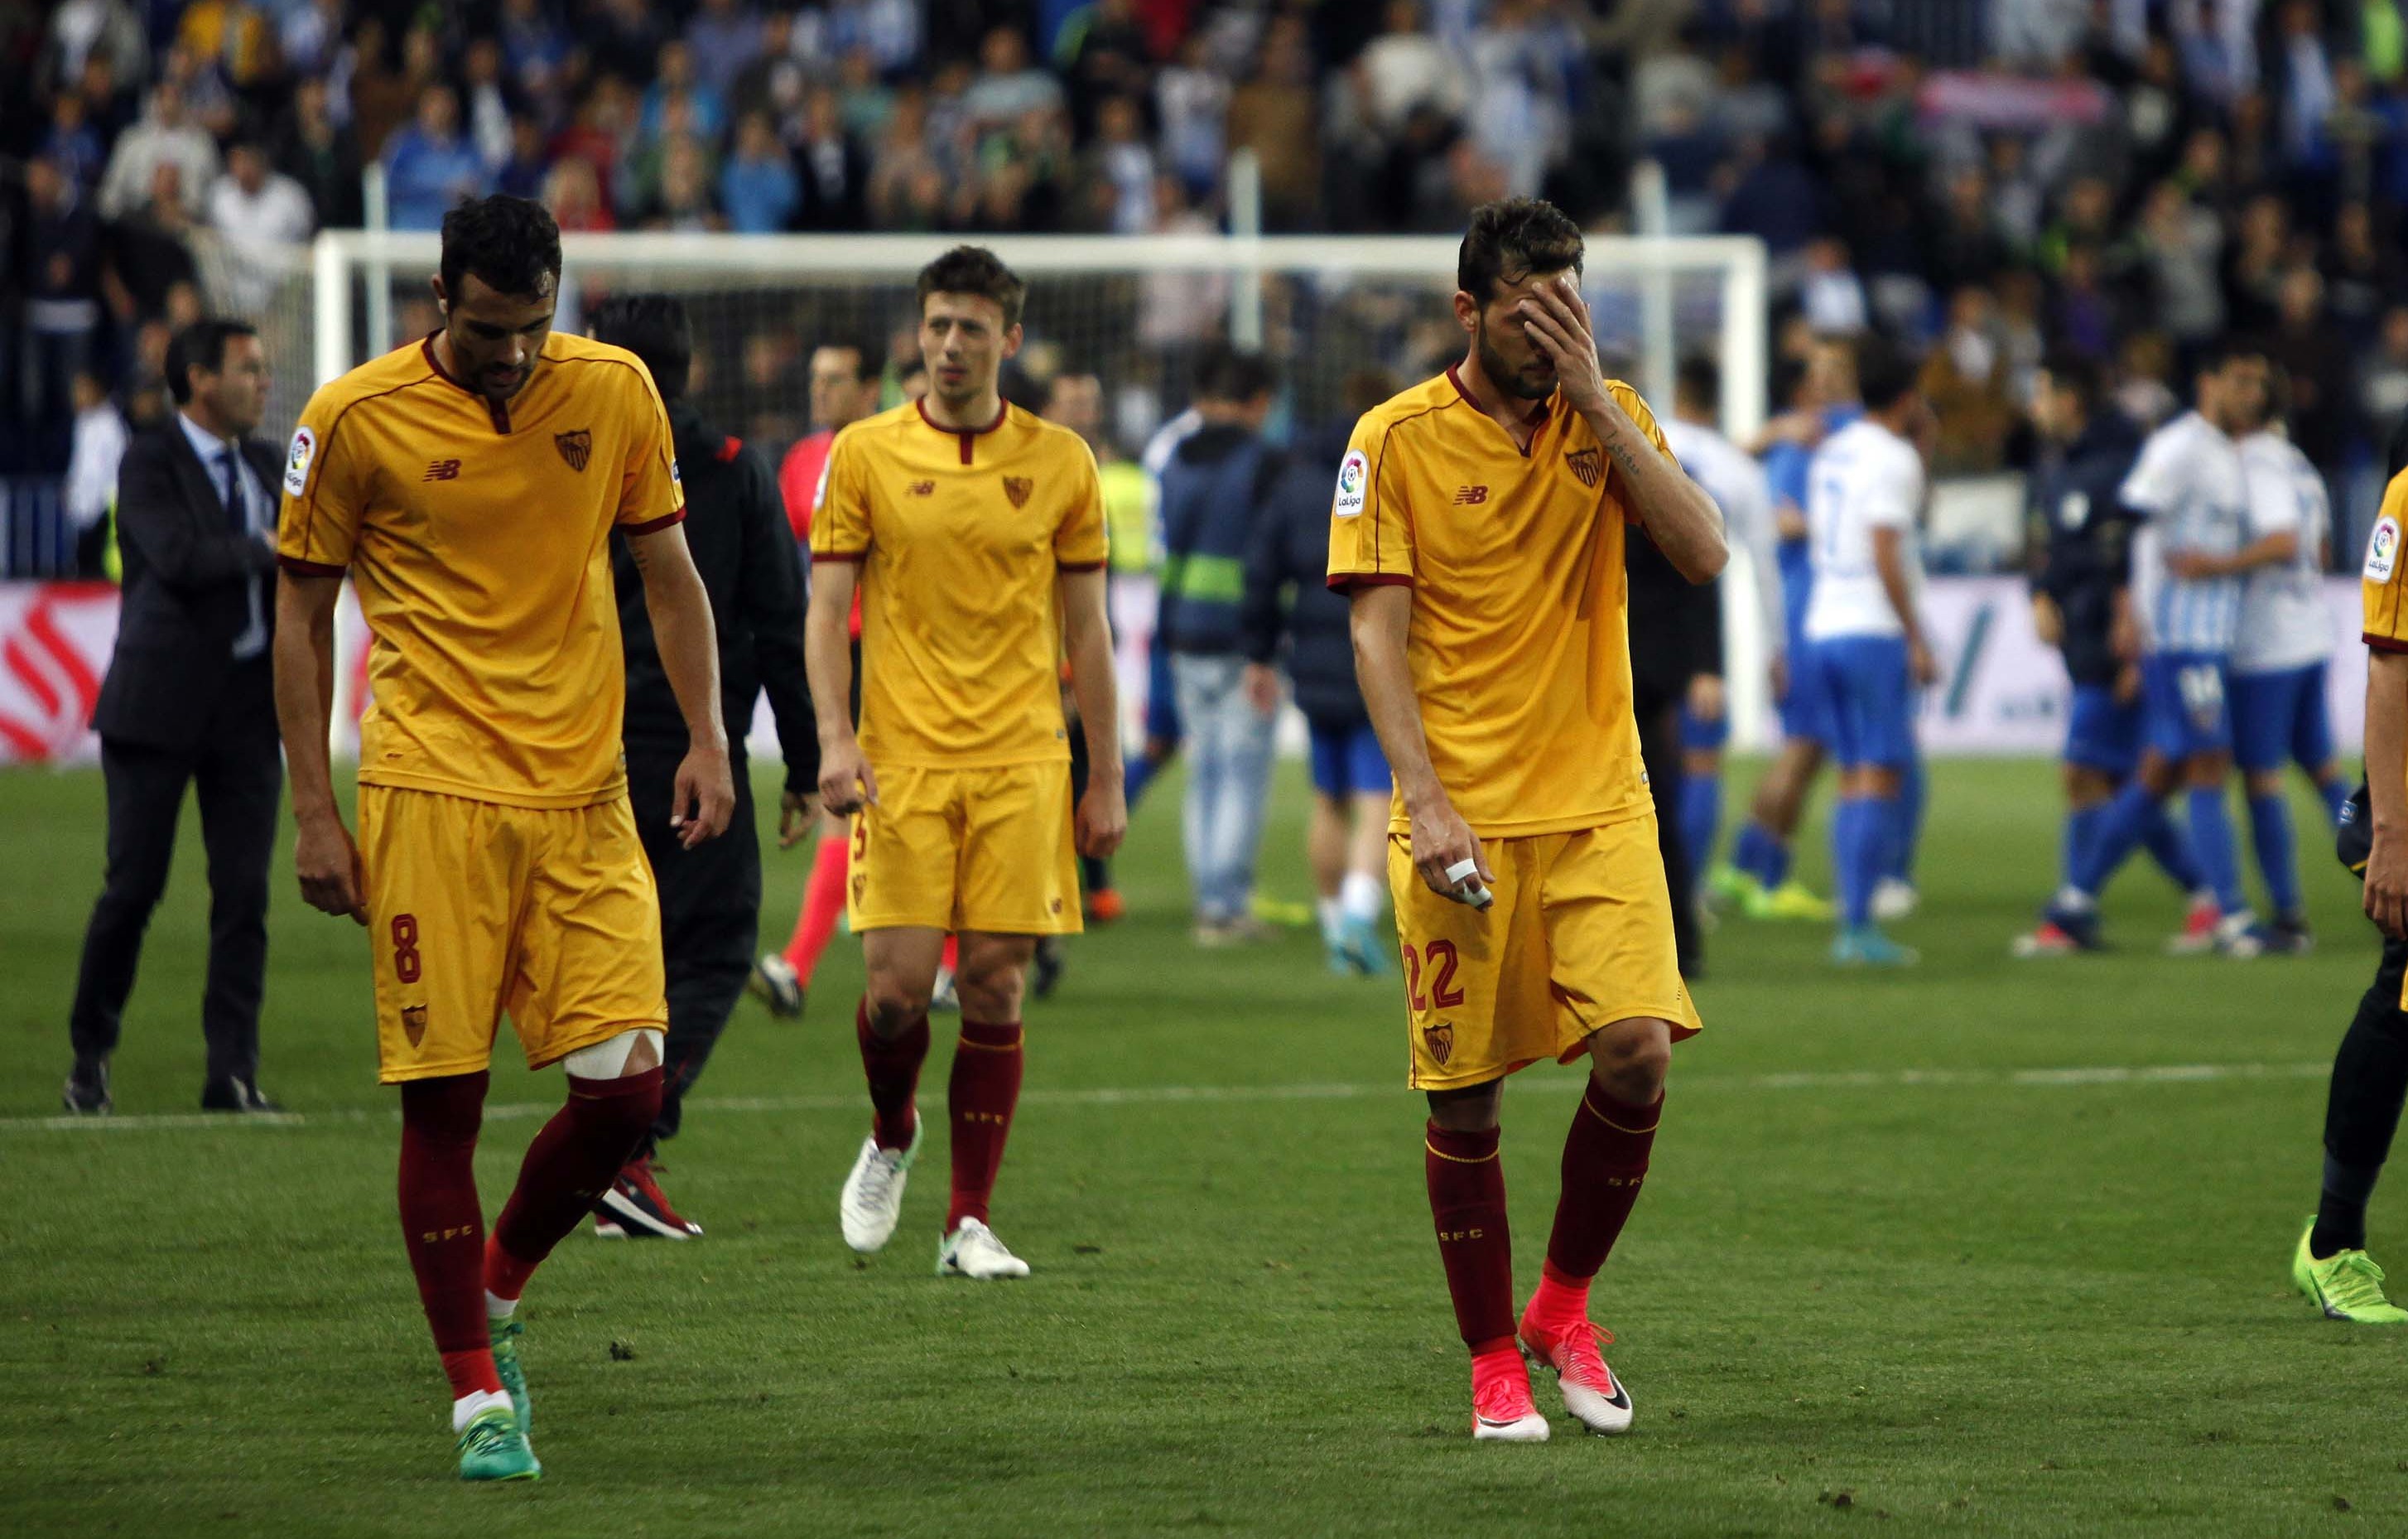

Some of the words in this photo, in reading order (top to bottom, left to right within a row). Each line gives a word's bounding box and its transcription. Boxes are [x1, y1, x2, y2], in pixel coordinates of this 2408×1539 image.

[422, 458, 462, 482] NB
[1338, 495, 1361, 507] LaLiga
[1452, 485, 1488, 505] NB
[391, 914, 422, 984] 8
[1403, 938, 1465, 1011] 22
[422, 1225, 473, 1242] SFC
[1440, 1228, 1484, 1242] SFC
